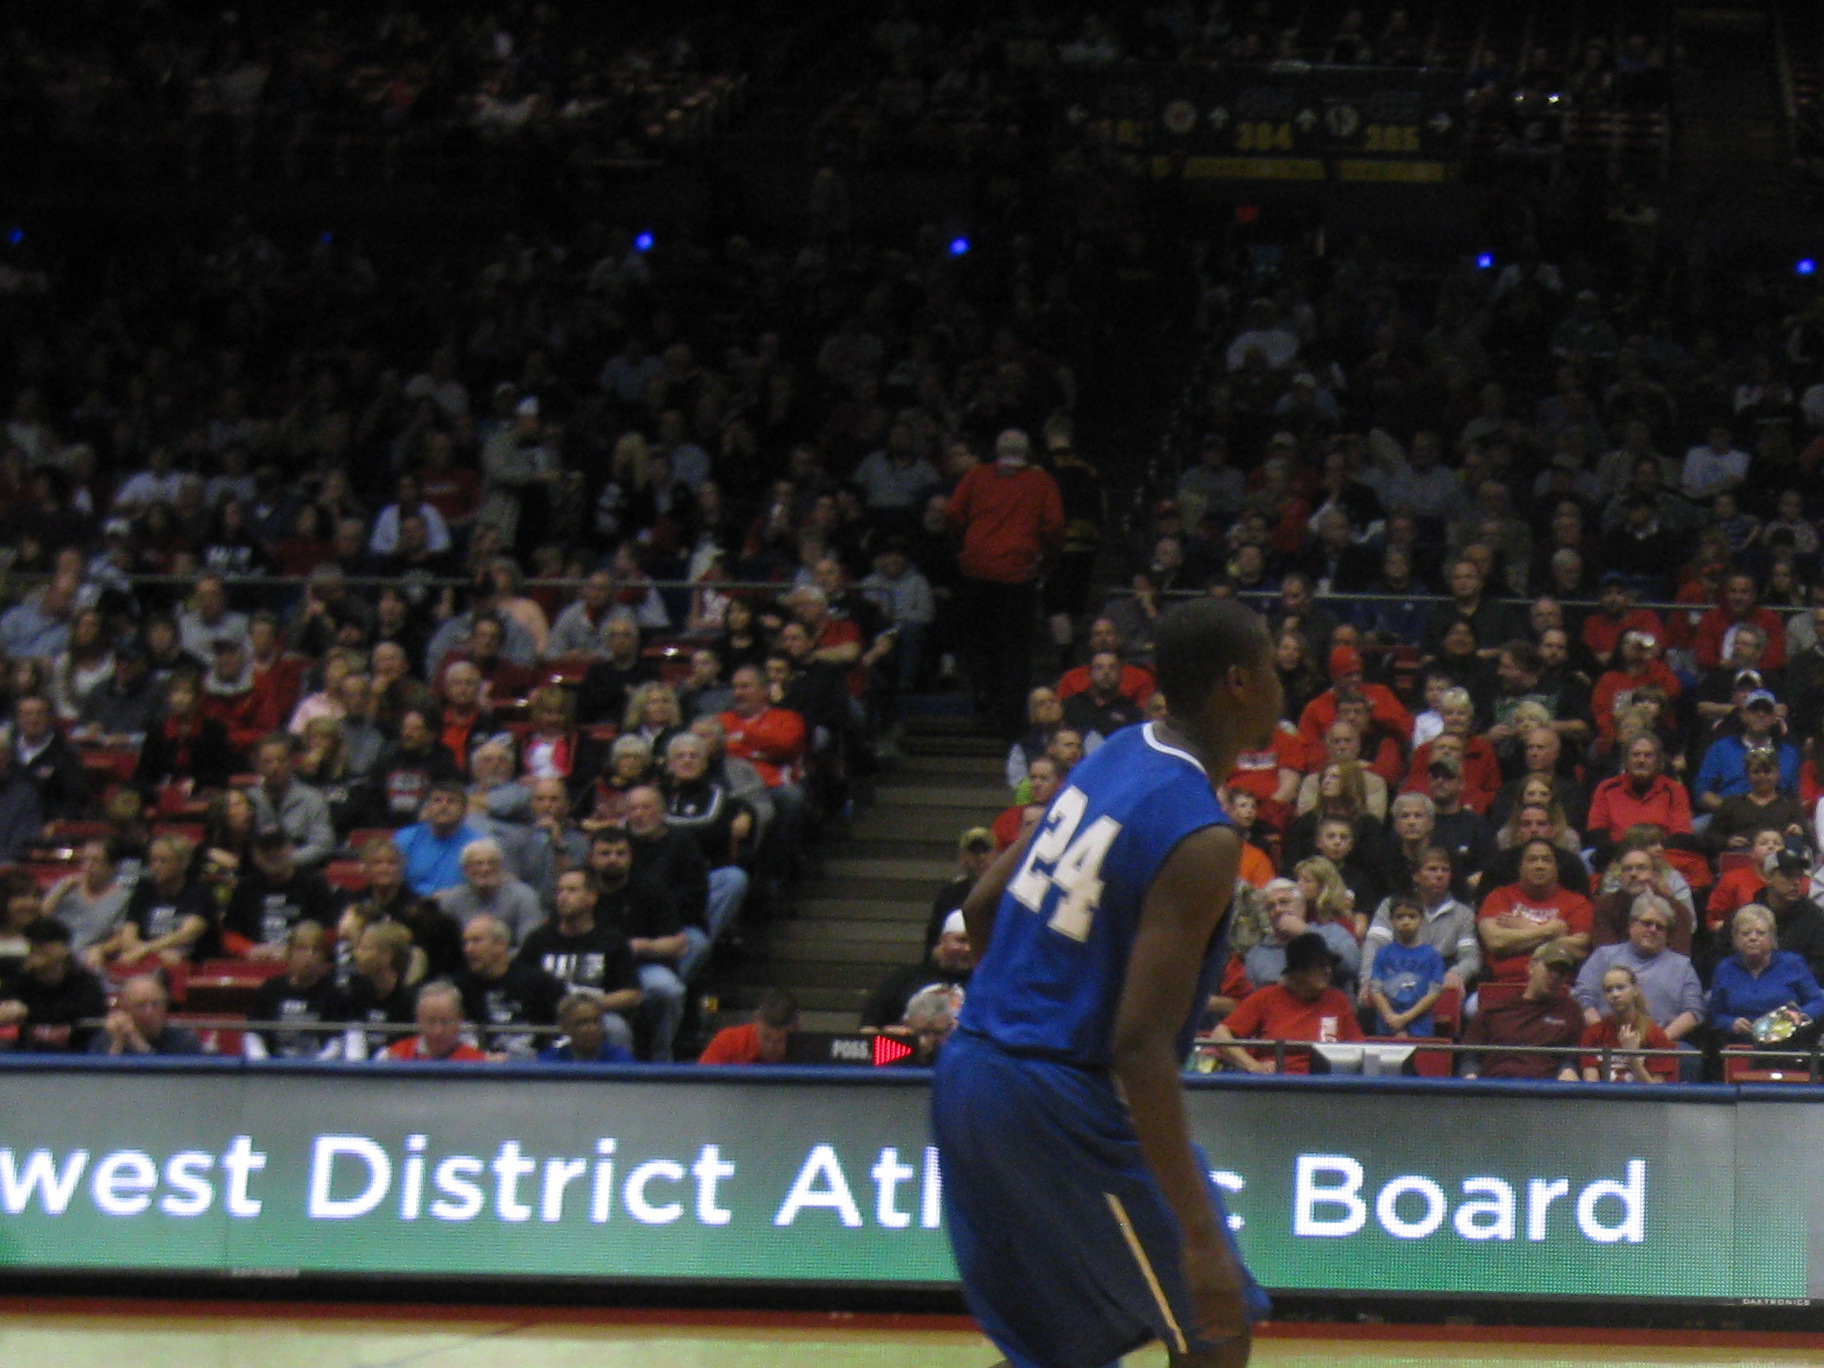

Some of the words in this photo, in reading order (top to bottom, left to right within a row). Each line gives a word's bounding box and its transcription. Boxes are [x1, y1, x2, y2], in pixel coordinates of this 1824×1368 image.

[1007, 785, 1123, 943] 24
[0, 1134, 267, 1216] west
[307, 1132, 736, 1226] District
[1291, 1152, 1648, 1244] Board
